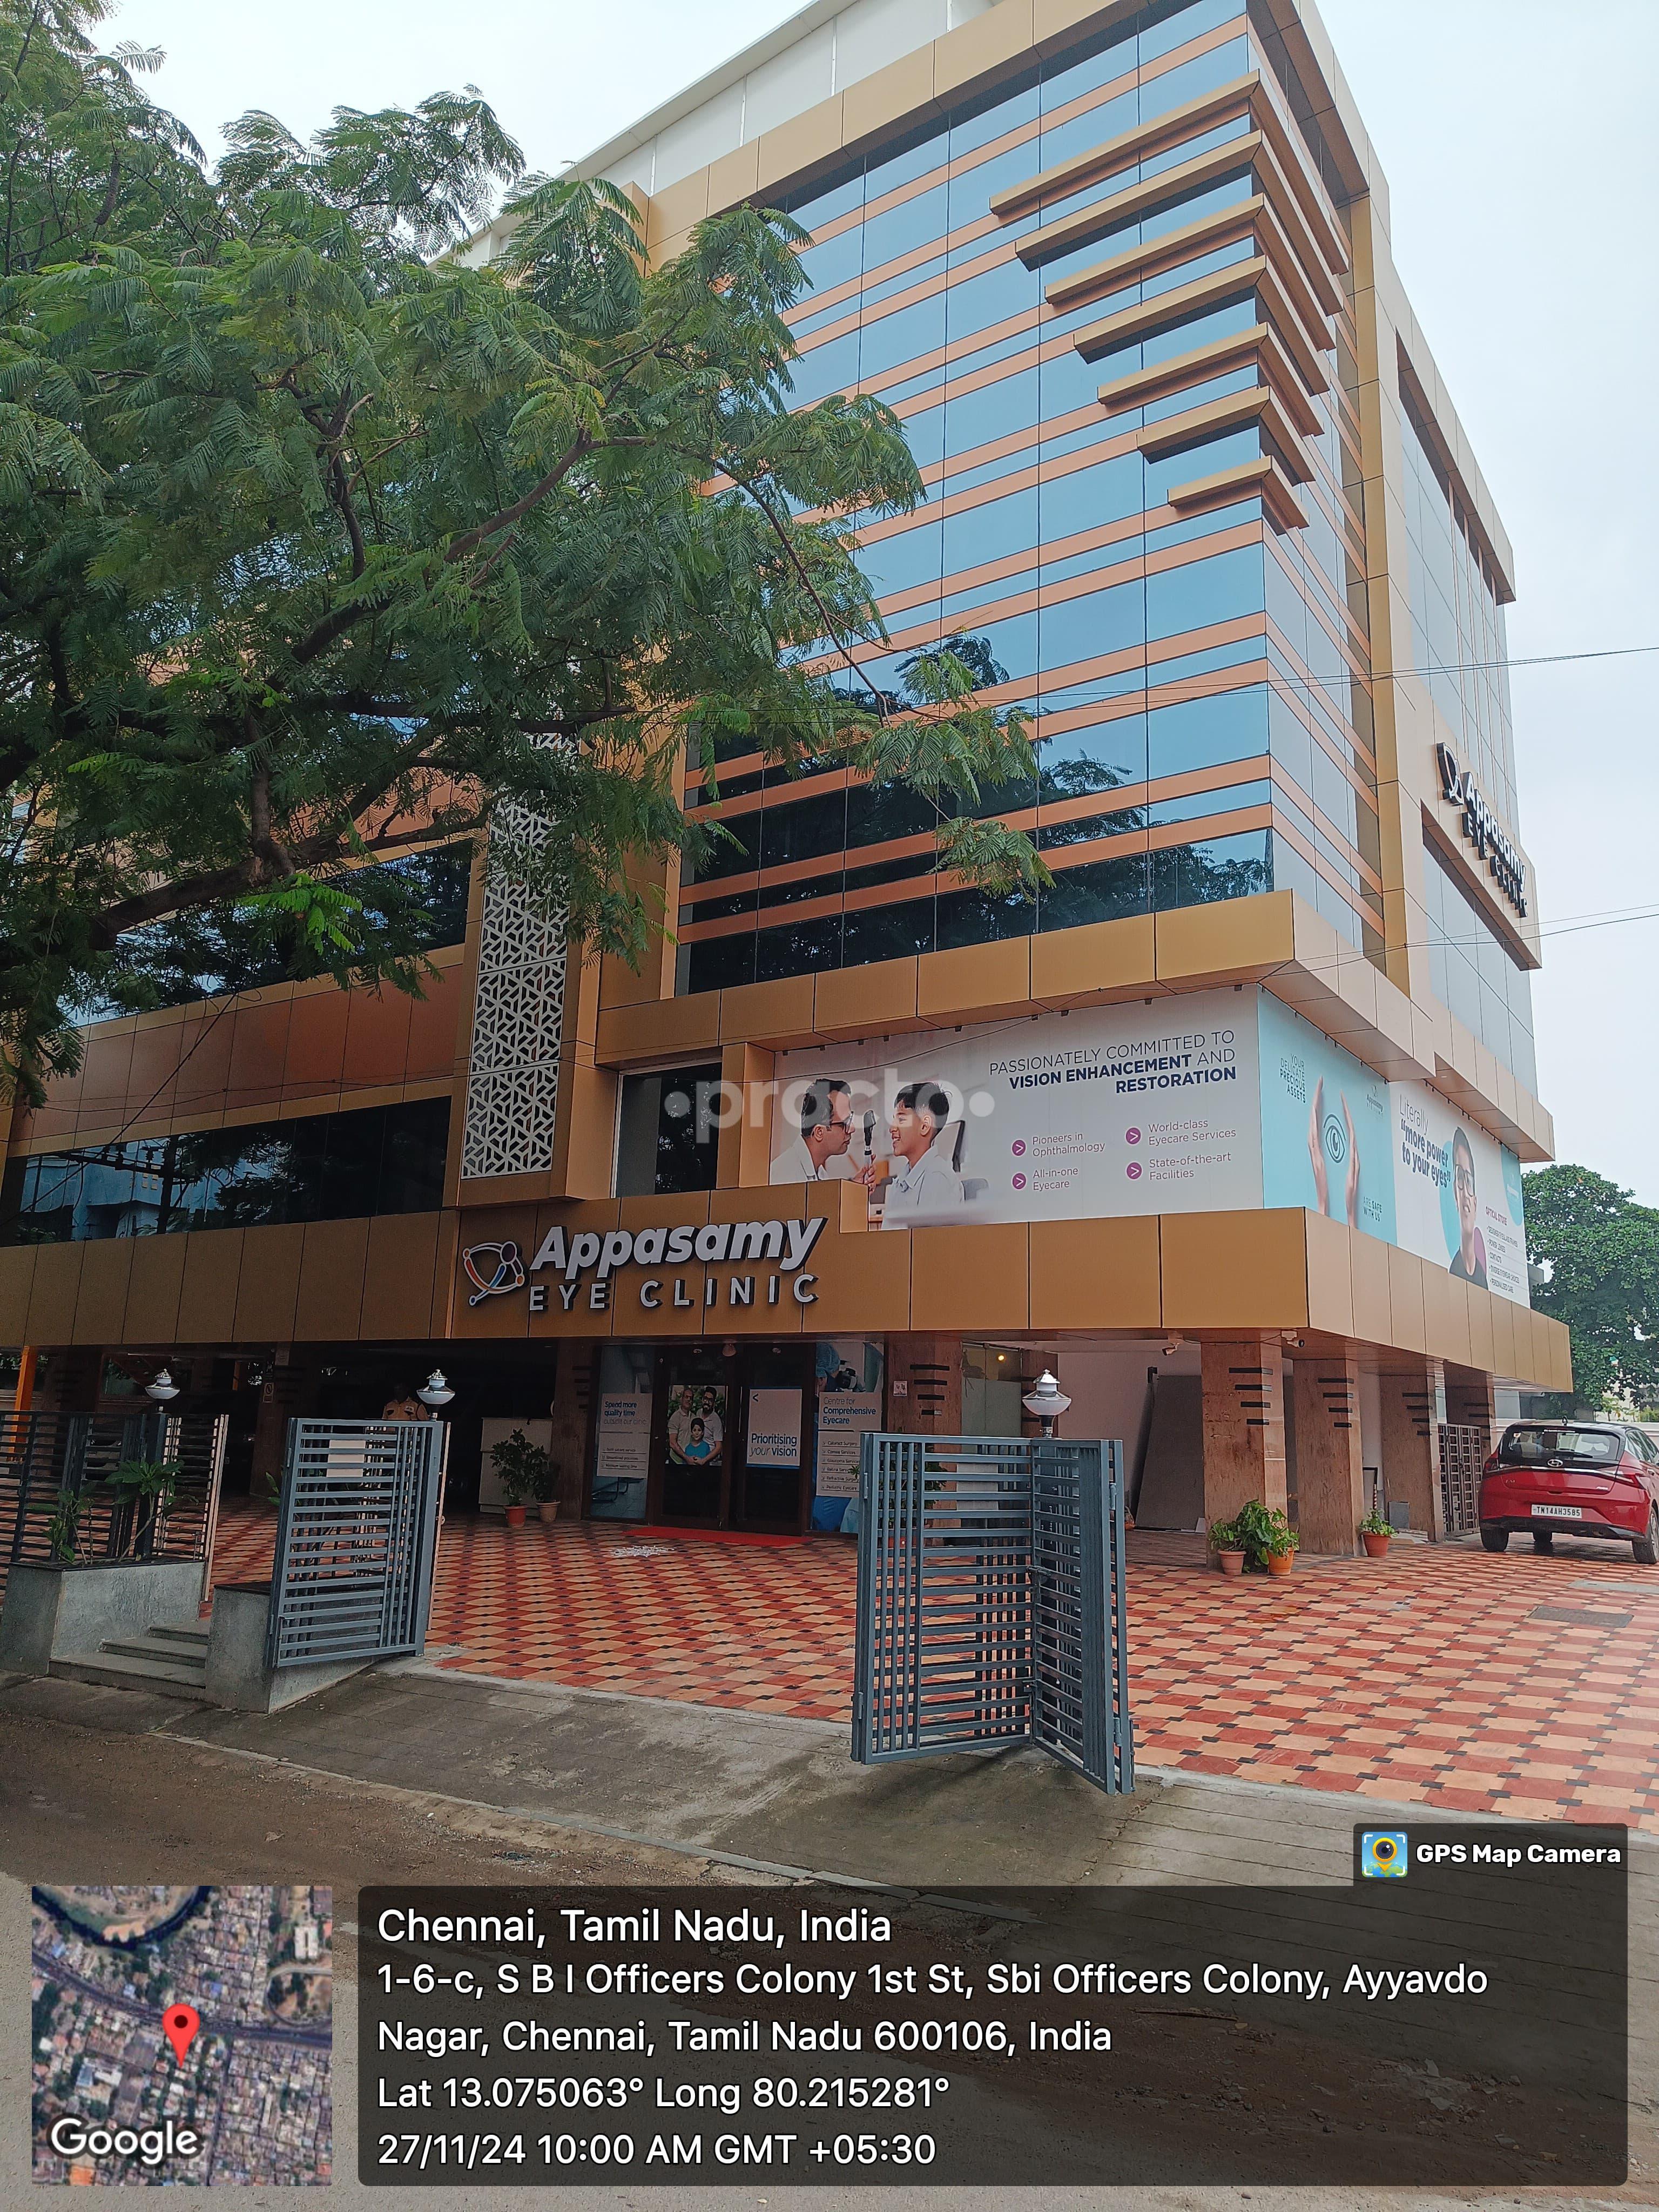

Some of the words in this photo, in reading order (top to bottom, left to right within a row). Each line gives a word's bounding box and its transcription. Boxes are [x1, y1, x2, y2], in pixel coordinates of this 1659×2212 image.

[1466, 772, 1526, 894] Appasamy
[990, 1048, 1101, 1075] PASSIONATELY
[1107, 1035, 1205, 1059] COMMITTED
[1211, 1030, 1235, 1045] TO
[1009, 1071, 1061, 1089] VISION
[1066, 1054, 1192, 1082] ENHANCEMENT
[1197, 1048, 1235, 1066] AND
[1280, 1057, 1305, 1082] DELICATE
[1291, 1054, 1305, 1071] YOUR
[1116, 1067, 1236, 1093] RESTORATION
[1280, 1068, 1305, 1092] PRECIOUS
[1287, 1084, 1306, 1103] ASSETS
[1400, 1094, 1428, 1135] Literally
[1149, 1119, 1209, 1134] World-class
[1033, 1134, 1072, 1145] Pioneers
[1075, 1132, 1083, 1141] in
[1149, 1134, 1189, 1146] Eyecare
[1192, 1129, 1236, 1141] Services
[1033, 1142, 1105, 1158] Ophthalmology
[1427, 1140, 1448, 1168] power
[1149, 1152, 1231, 1168] State-of-the-art
[1402, 1142, 1411, 1165] to
[1413, 1152, 1430, 1177] your
[1033, 1167, 1078, 1178] All-in-one
[1149, 1169, 1194, 1181] Facilities
[1033, 1179, 1070, 1191] Eyecare
[529, 1217, 828, 1280] Appasamy
[529, 1283, 611, 1311] EYE
[640, 1274, 819, 1308] CLINIC
[605, 1401, 622, 1409] Spend
[824, 1397, 845, 1405] Centre
[604, 1410, 622, 1418] quality
[823, 1407, 876, 1415] Comprehensive
[823, 1416, 849, 1425] Eyecare
[751, 1433, 797, 1447] Prioritising
[749, 1447, 770, 1457] your
[772, 1445, 797, 1456] vision
[1537, 1506, 1580, 1516] TN14AH3585
